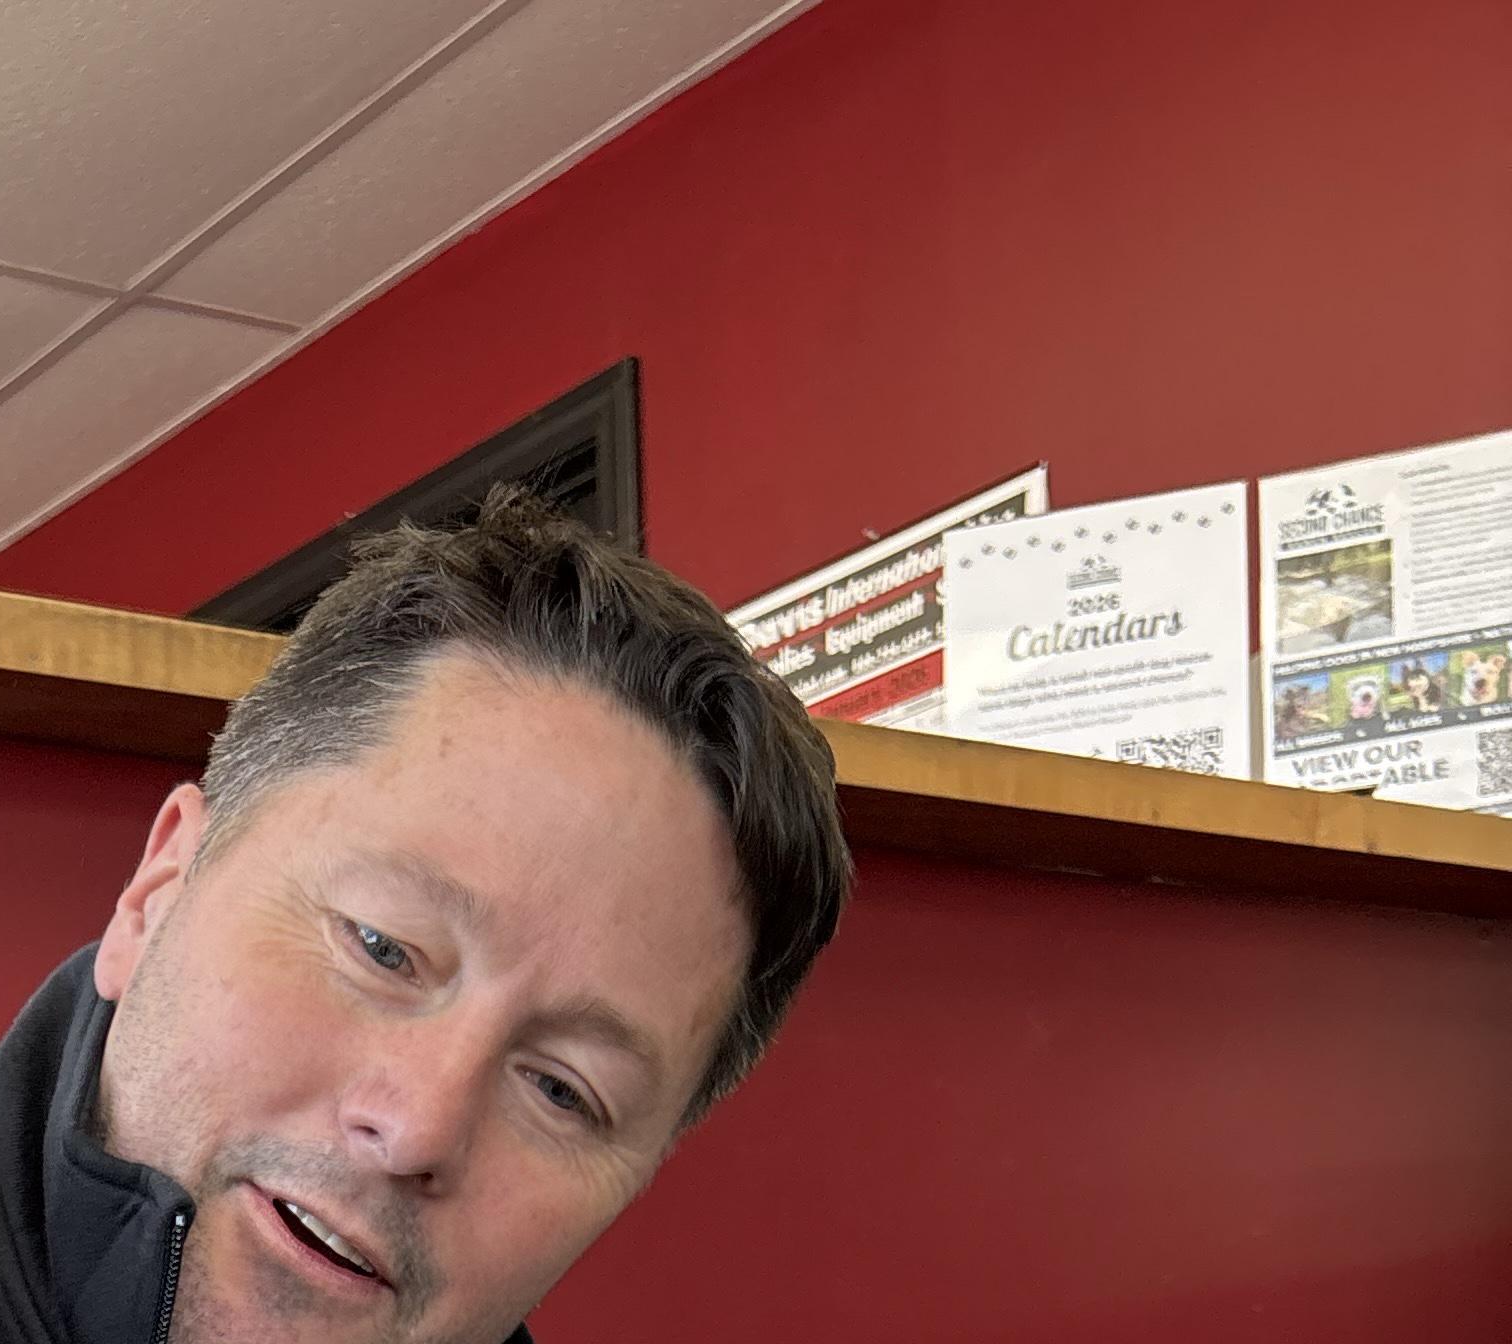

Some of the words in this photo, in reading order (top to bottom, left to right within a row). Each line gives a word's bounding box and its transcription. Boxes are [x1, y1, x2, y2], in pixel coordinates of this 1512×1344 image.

[1067, 592, 1121, 617] 2026
[1007, 611, 1187, 661] Calendars
[1291, 750, 1358, 777] VIEW
[1363, 740, 1424, 765] OUR
